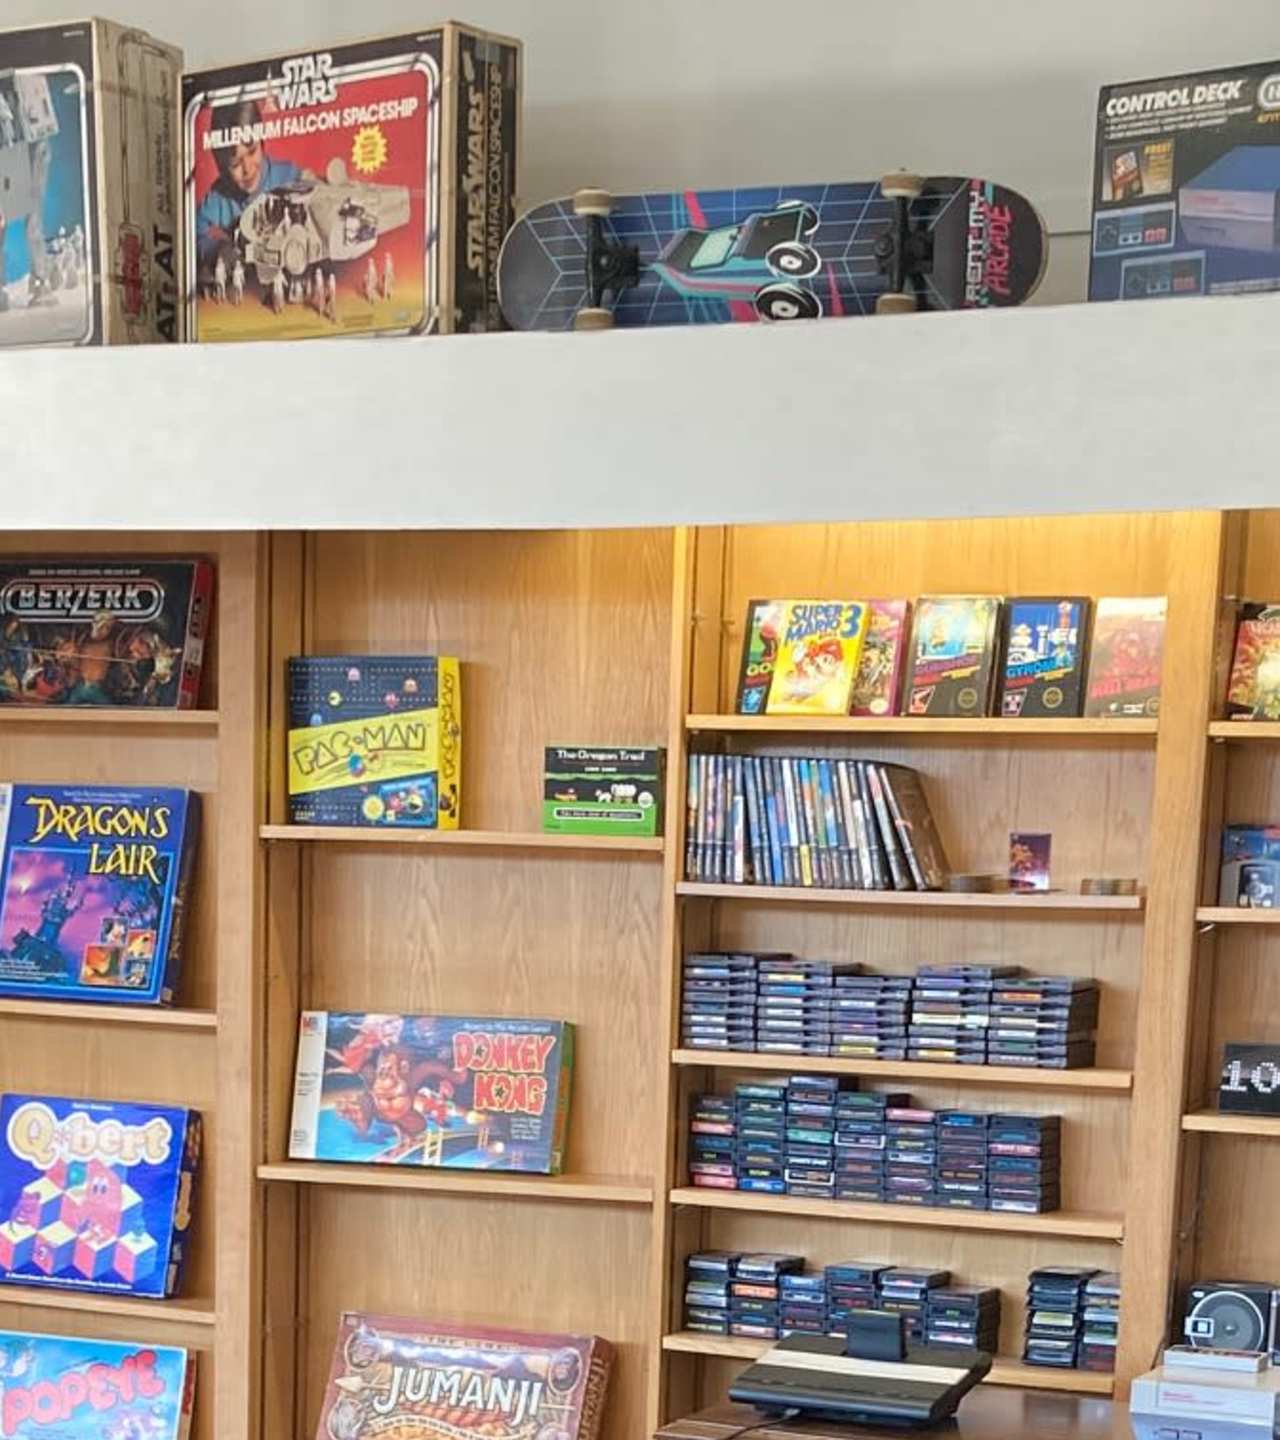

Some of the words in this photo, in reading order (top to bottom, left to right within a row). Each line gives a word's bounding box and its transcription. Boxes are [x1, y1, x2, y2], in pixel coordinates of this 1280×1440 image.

[279, 54, 333, 84] STAR
[274, 81, 338, 112] WARS
[1105, 87, 1190, 117] CONTROL
[1192, 80, 1244, 104] DECK
[203, 117, 282, 150] MILLENNIUM
[282, 110, 340, 138] FALCON
[342, 98, 418, 128] SPACESHIP
[463, 86, 487, 191] WARS
[19, 583, 143, 613] BERZERK
[791, 604, 843, 625] SUPER
[785, 618, 841, 642] MARIO
[840, 604, 862, 638] 3
[89, 843, 161, 884] LAIR
[453, 1031, 556, 1073] DONKEY
[473, 1072, 548, 1117] KONG
[1, 1349, 168, 1436] POPEYE
[372, 1365, 544, 1428] JUMANJI
